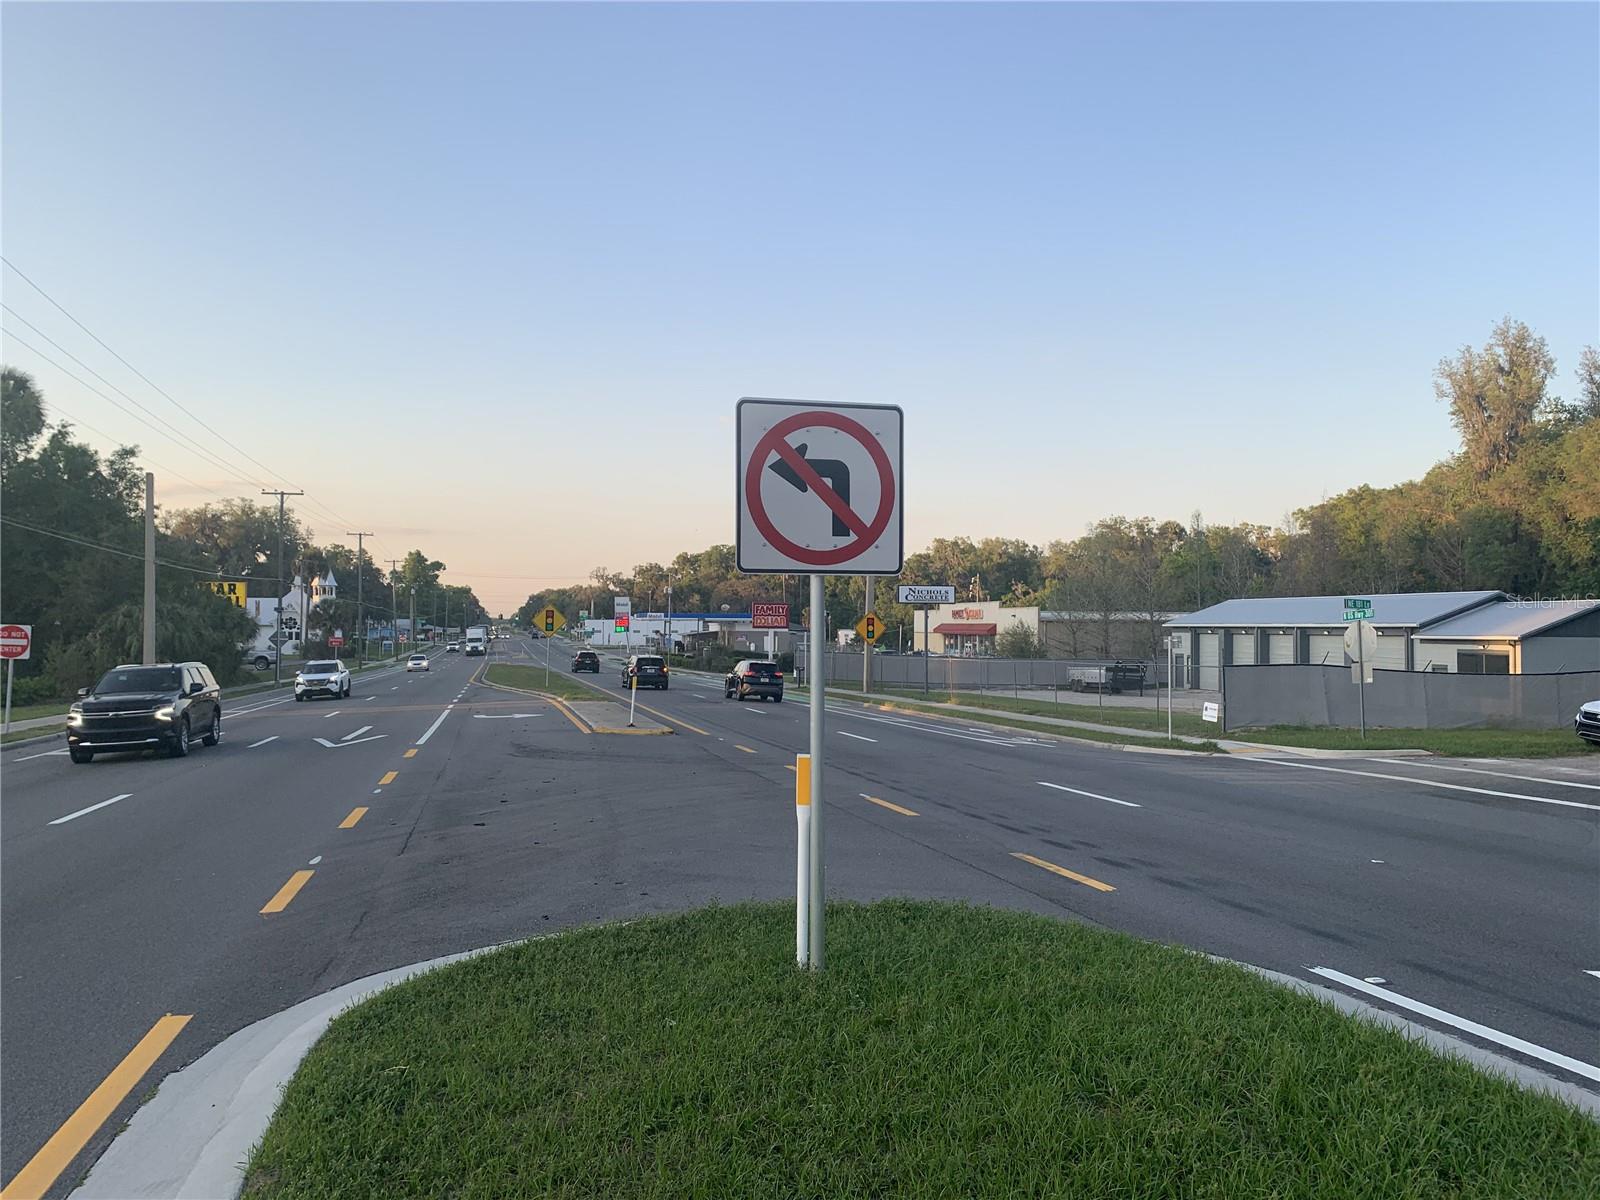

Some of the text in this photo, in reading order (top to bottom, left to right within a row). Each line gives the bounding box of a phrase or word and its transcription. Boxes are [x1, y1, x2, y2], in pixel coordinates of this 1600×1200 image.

[908, 587, 949, 595] NICHOLS
[754, 604, 787, 615] FAMILY
[754, 615, 787, 627] DOLLAR
